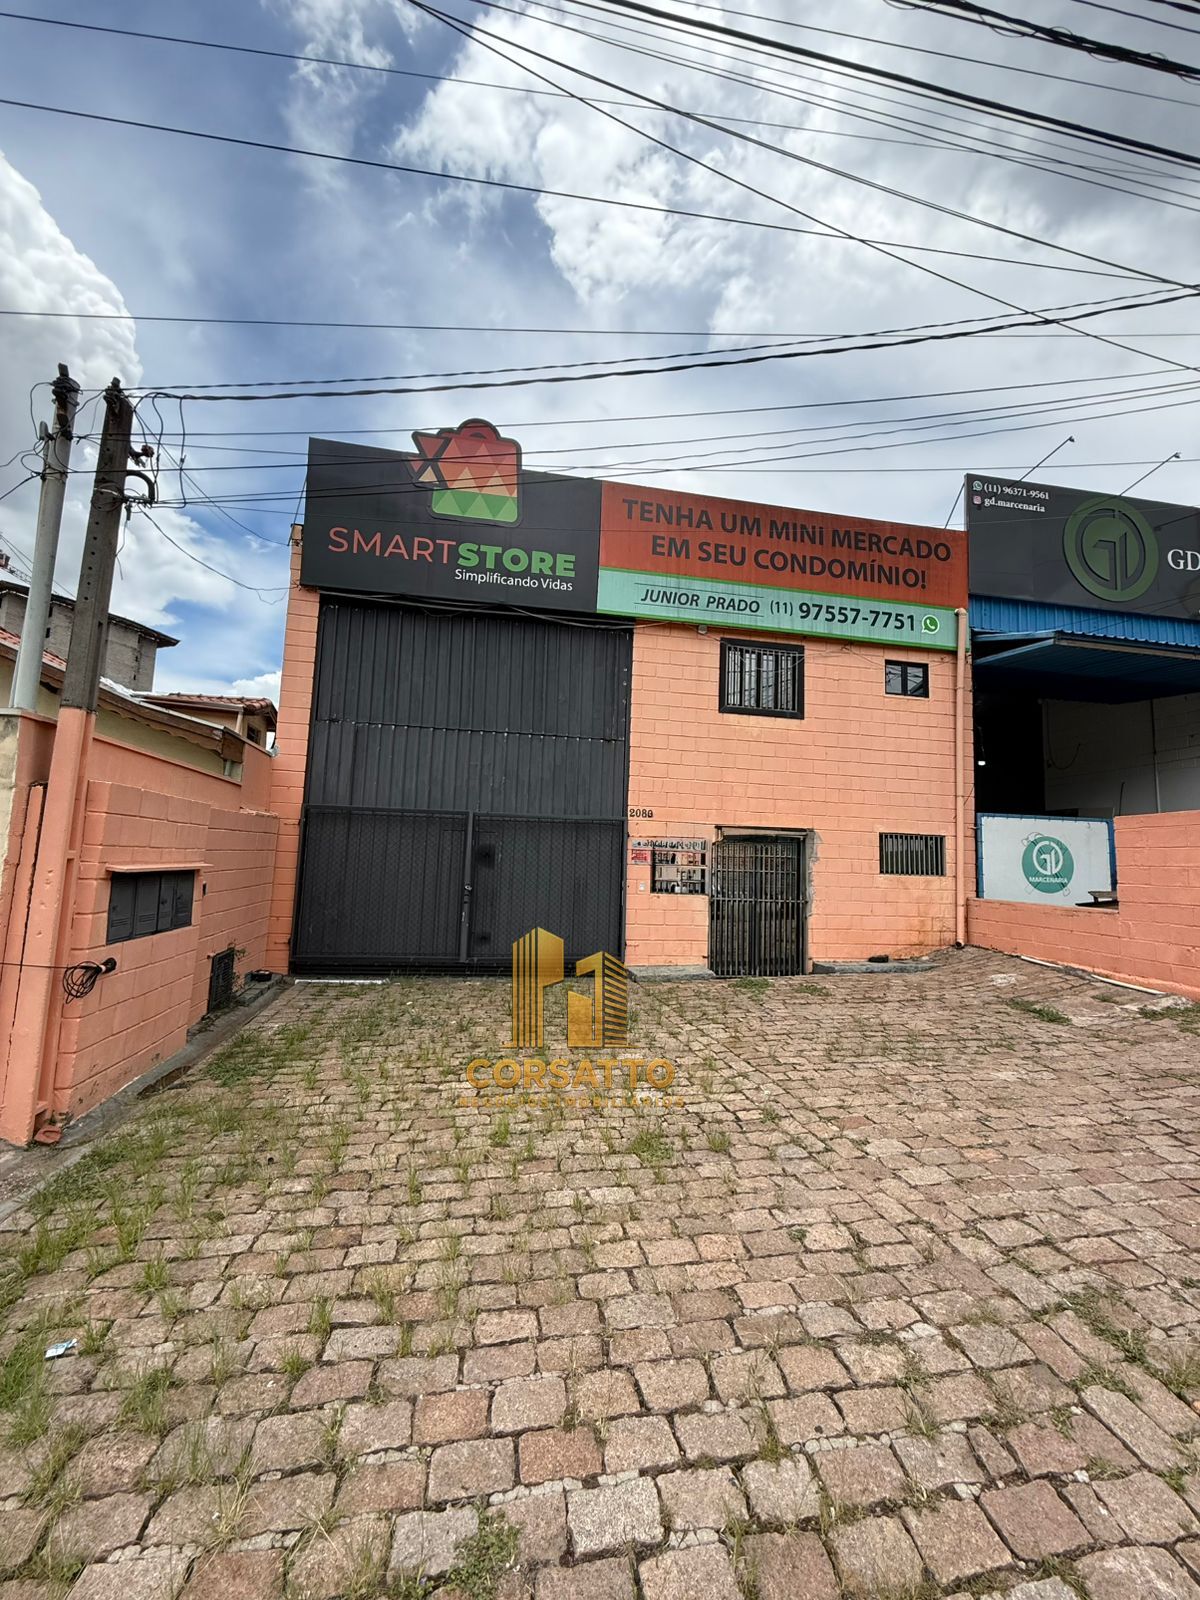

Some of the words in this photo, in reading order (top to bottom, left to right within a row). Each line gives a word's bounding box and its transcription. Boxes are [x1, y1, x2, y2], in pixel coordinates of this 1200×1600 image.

[984, 482, 1001, 493] (11)
[1002, 485, 1050, 500] 96371-9561
[984, 497, 1046, 512] gd.marcenaria
[622, 498, 713, 530] TENHA
[720, 512, 762, 536] UM
[831, 529, 952, 562] MERCADO
[651, 535, 690, 559] EM
[698, 542, 746, 566] SEU
[754, 549, 927, 590] CONDOMÍNIO!
[1167, 549, 1200, 571] GD
[454, 568, 538, 588] Simplificando
[541, 577, 573, 591] Vidas
[641, 588, 700, 607] JUNIOR
[706, 595, 760, 613] PRADO
[770, 599, 793, 618] (11)
[798, 602, 915, 632] 97557-7751
[1029, 876, 1068, 884] MARCENARIA
